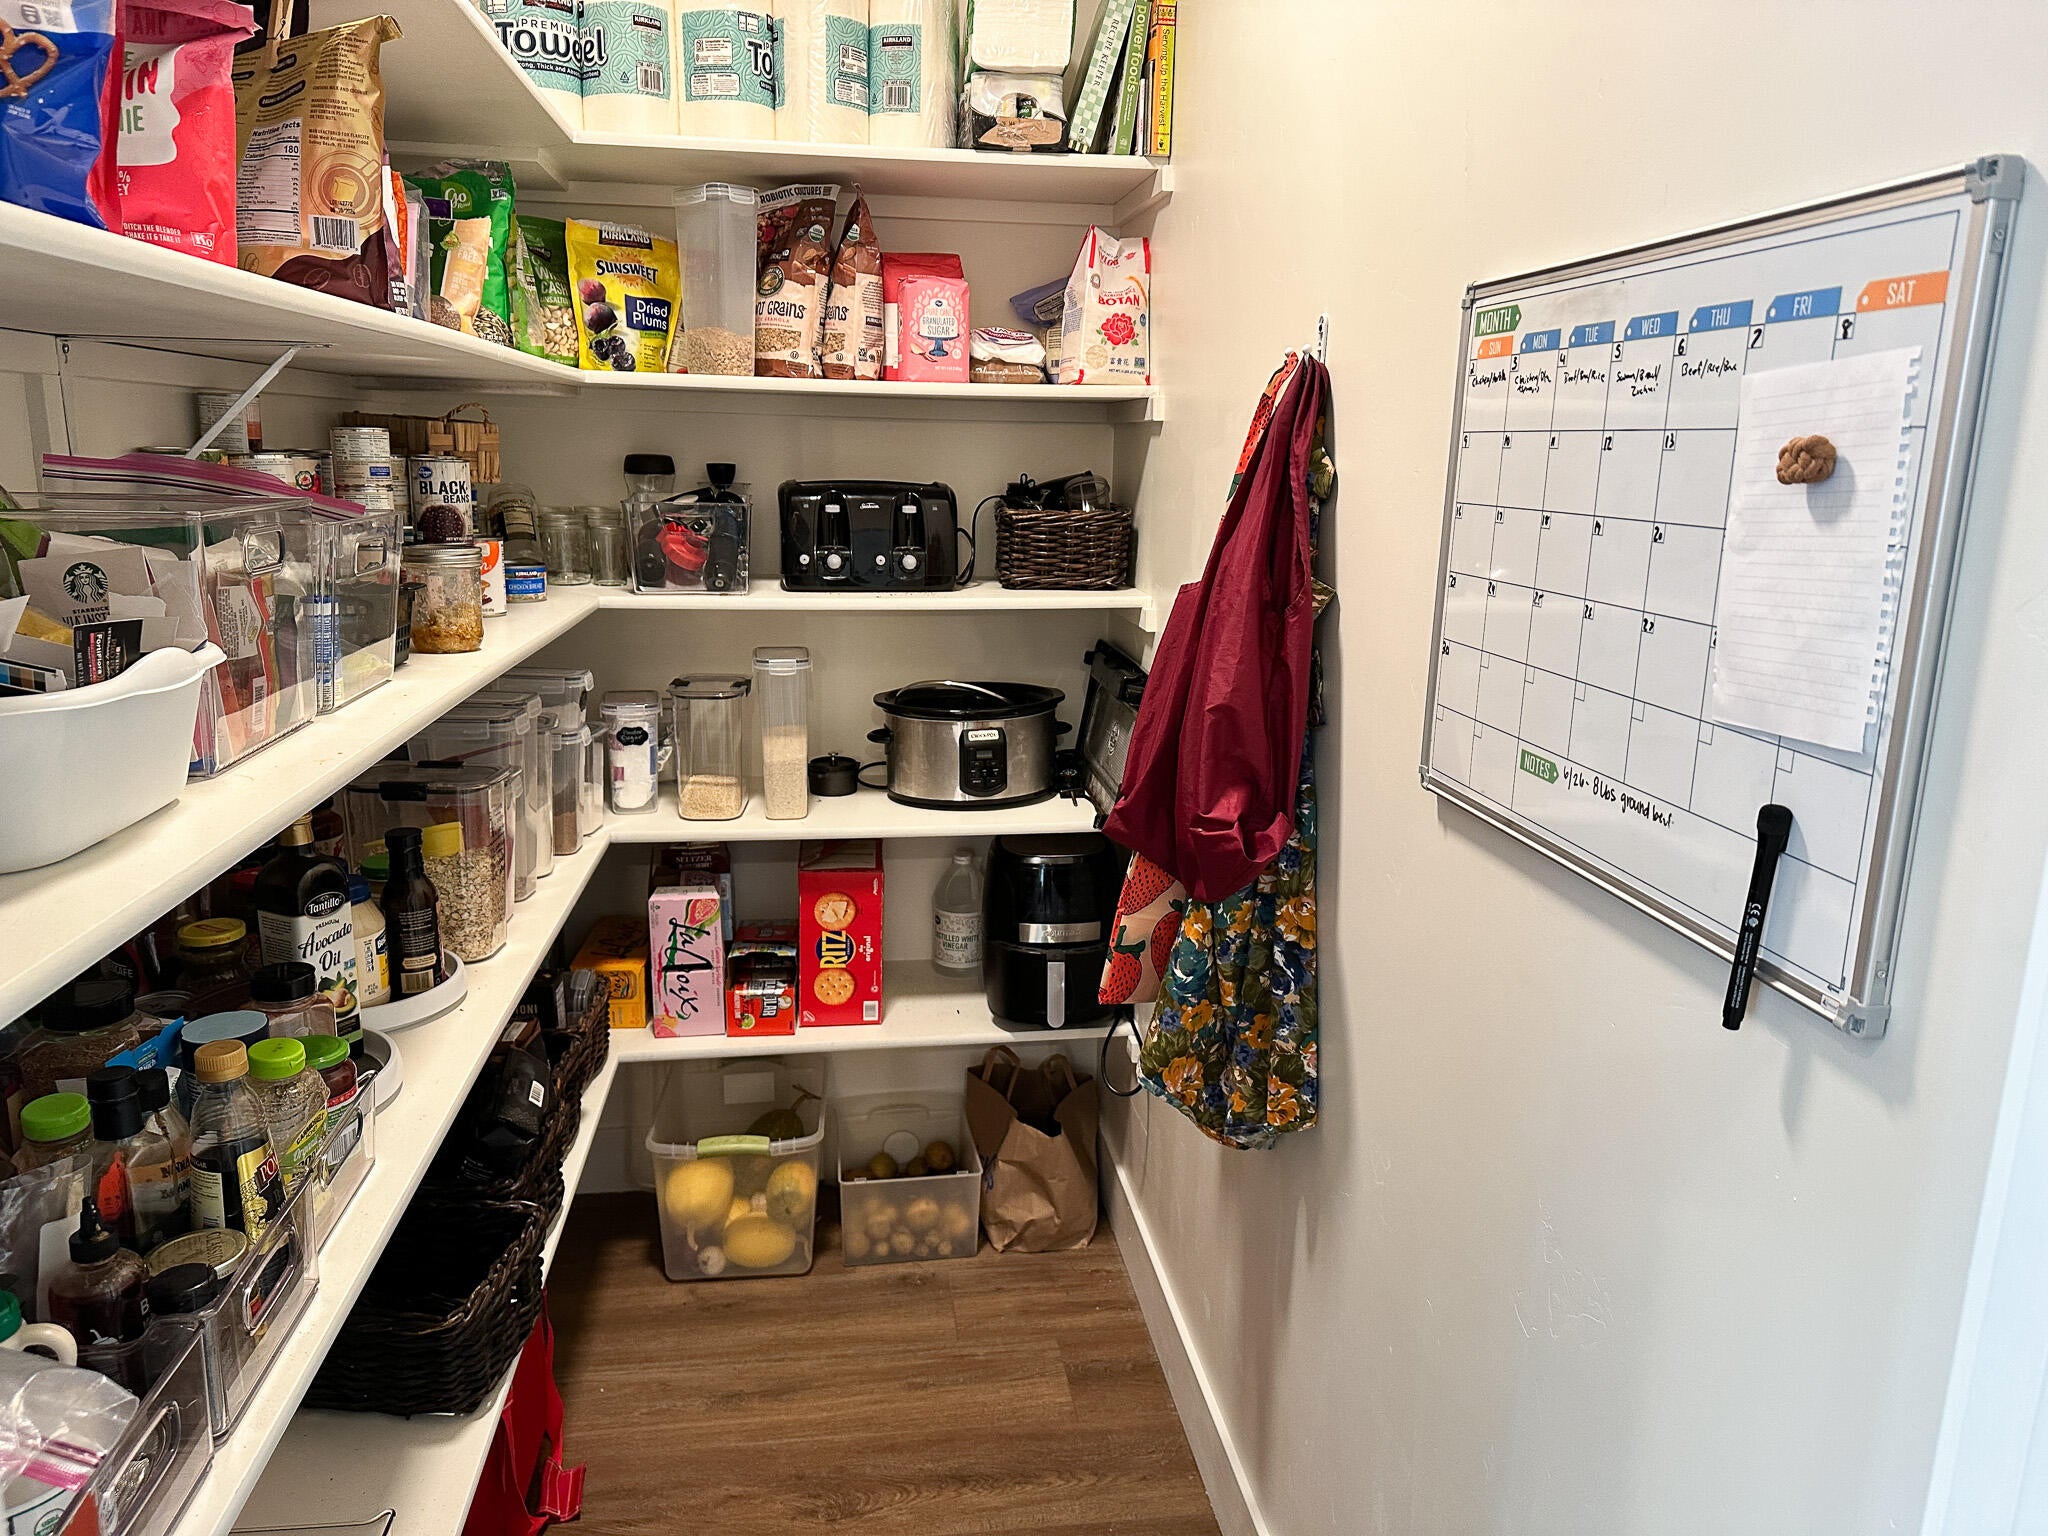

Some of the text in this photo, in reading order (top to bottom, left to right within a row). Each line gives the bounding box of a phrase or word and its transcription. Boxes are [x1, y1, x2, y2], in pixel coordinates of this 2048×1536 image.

[1093, 18, 1119, 86] RECIPE KEEPER
[1127, 5, 1147, 93] power foods
[537, 63, 553, 71] Thick
[1159, 28, 1171, 126] Serving Up the Harvest
[251, 121, 301, 136] Nutrition Facts
[283, 145, 299, 154] 180
[143, 224, 155, 232] THE
[155, 225, 182, 236] BLENDER
[601, 230, 650, 244] KIRKLAND
[596, 259, 659, 285] SUNSWEET
[1097, 295, 1140, 307] BOTAN
[1886, 280, 1916, 305] SAT
[636, 299, 668, 318] Dried
[1793, 296, 1812, 317] FRI
[632, 311, 668, 330] Plums
[922, 315, 956, 327] GRANULATED
[1478, 310, 1511, 334] MONTH
[1710, 307, 1731, 327] THU
[927, 326, 950, 337] SUGAR
[1584, 325, 1599, 343] TUE
[1641, 317, 1661, 336] WED
[1841, 318, 1853, 340] 8
[1532, 334, 1548, 349] MON
[1677, 338, 1685, 356] 6
[1750, 328, 1762, 349] 7
[1488, 341, 1501, 355] SUN
[1614, 344, 1621, 359] 5
[1511, 356, 1518, 371] 3
[1559, 353, 1566, 365] 4
[1603, 435, 1613, 451] 12
[1664, 432, 1675, 449] 13
[419, 480, 467, 495] BLACK
[443, 494, 470, 504] BEANS
[1653, 525, 1663, 543] 20
[1523, 753, 1551, 780] NOTES
[1620, 792, 1651, 819] ground
[675, 854, 712, 863] SELTZER
[308, 896, 340, 914] Tantillo
[298, 922, 353, 959] Avocado
[819, 929, 847, 969] RITZ
[863, 935, 874, 962] original
[942, 942, 968, 950] VINEGAR
[319, 950, 341, 972] Oil
